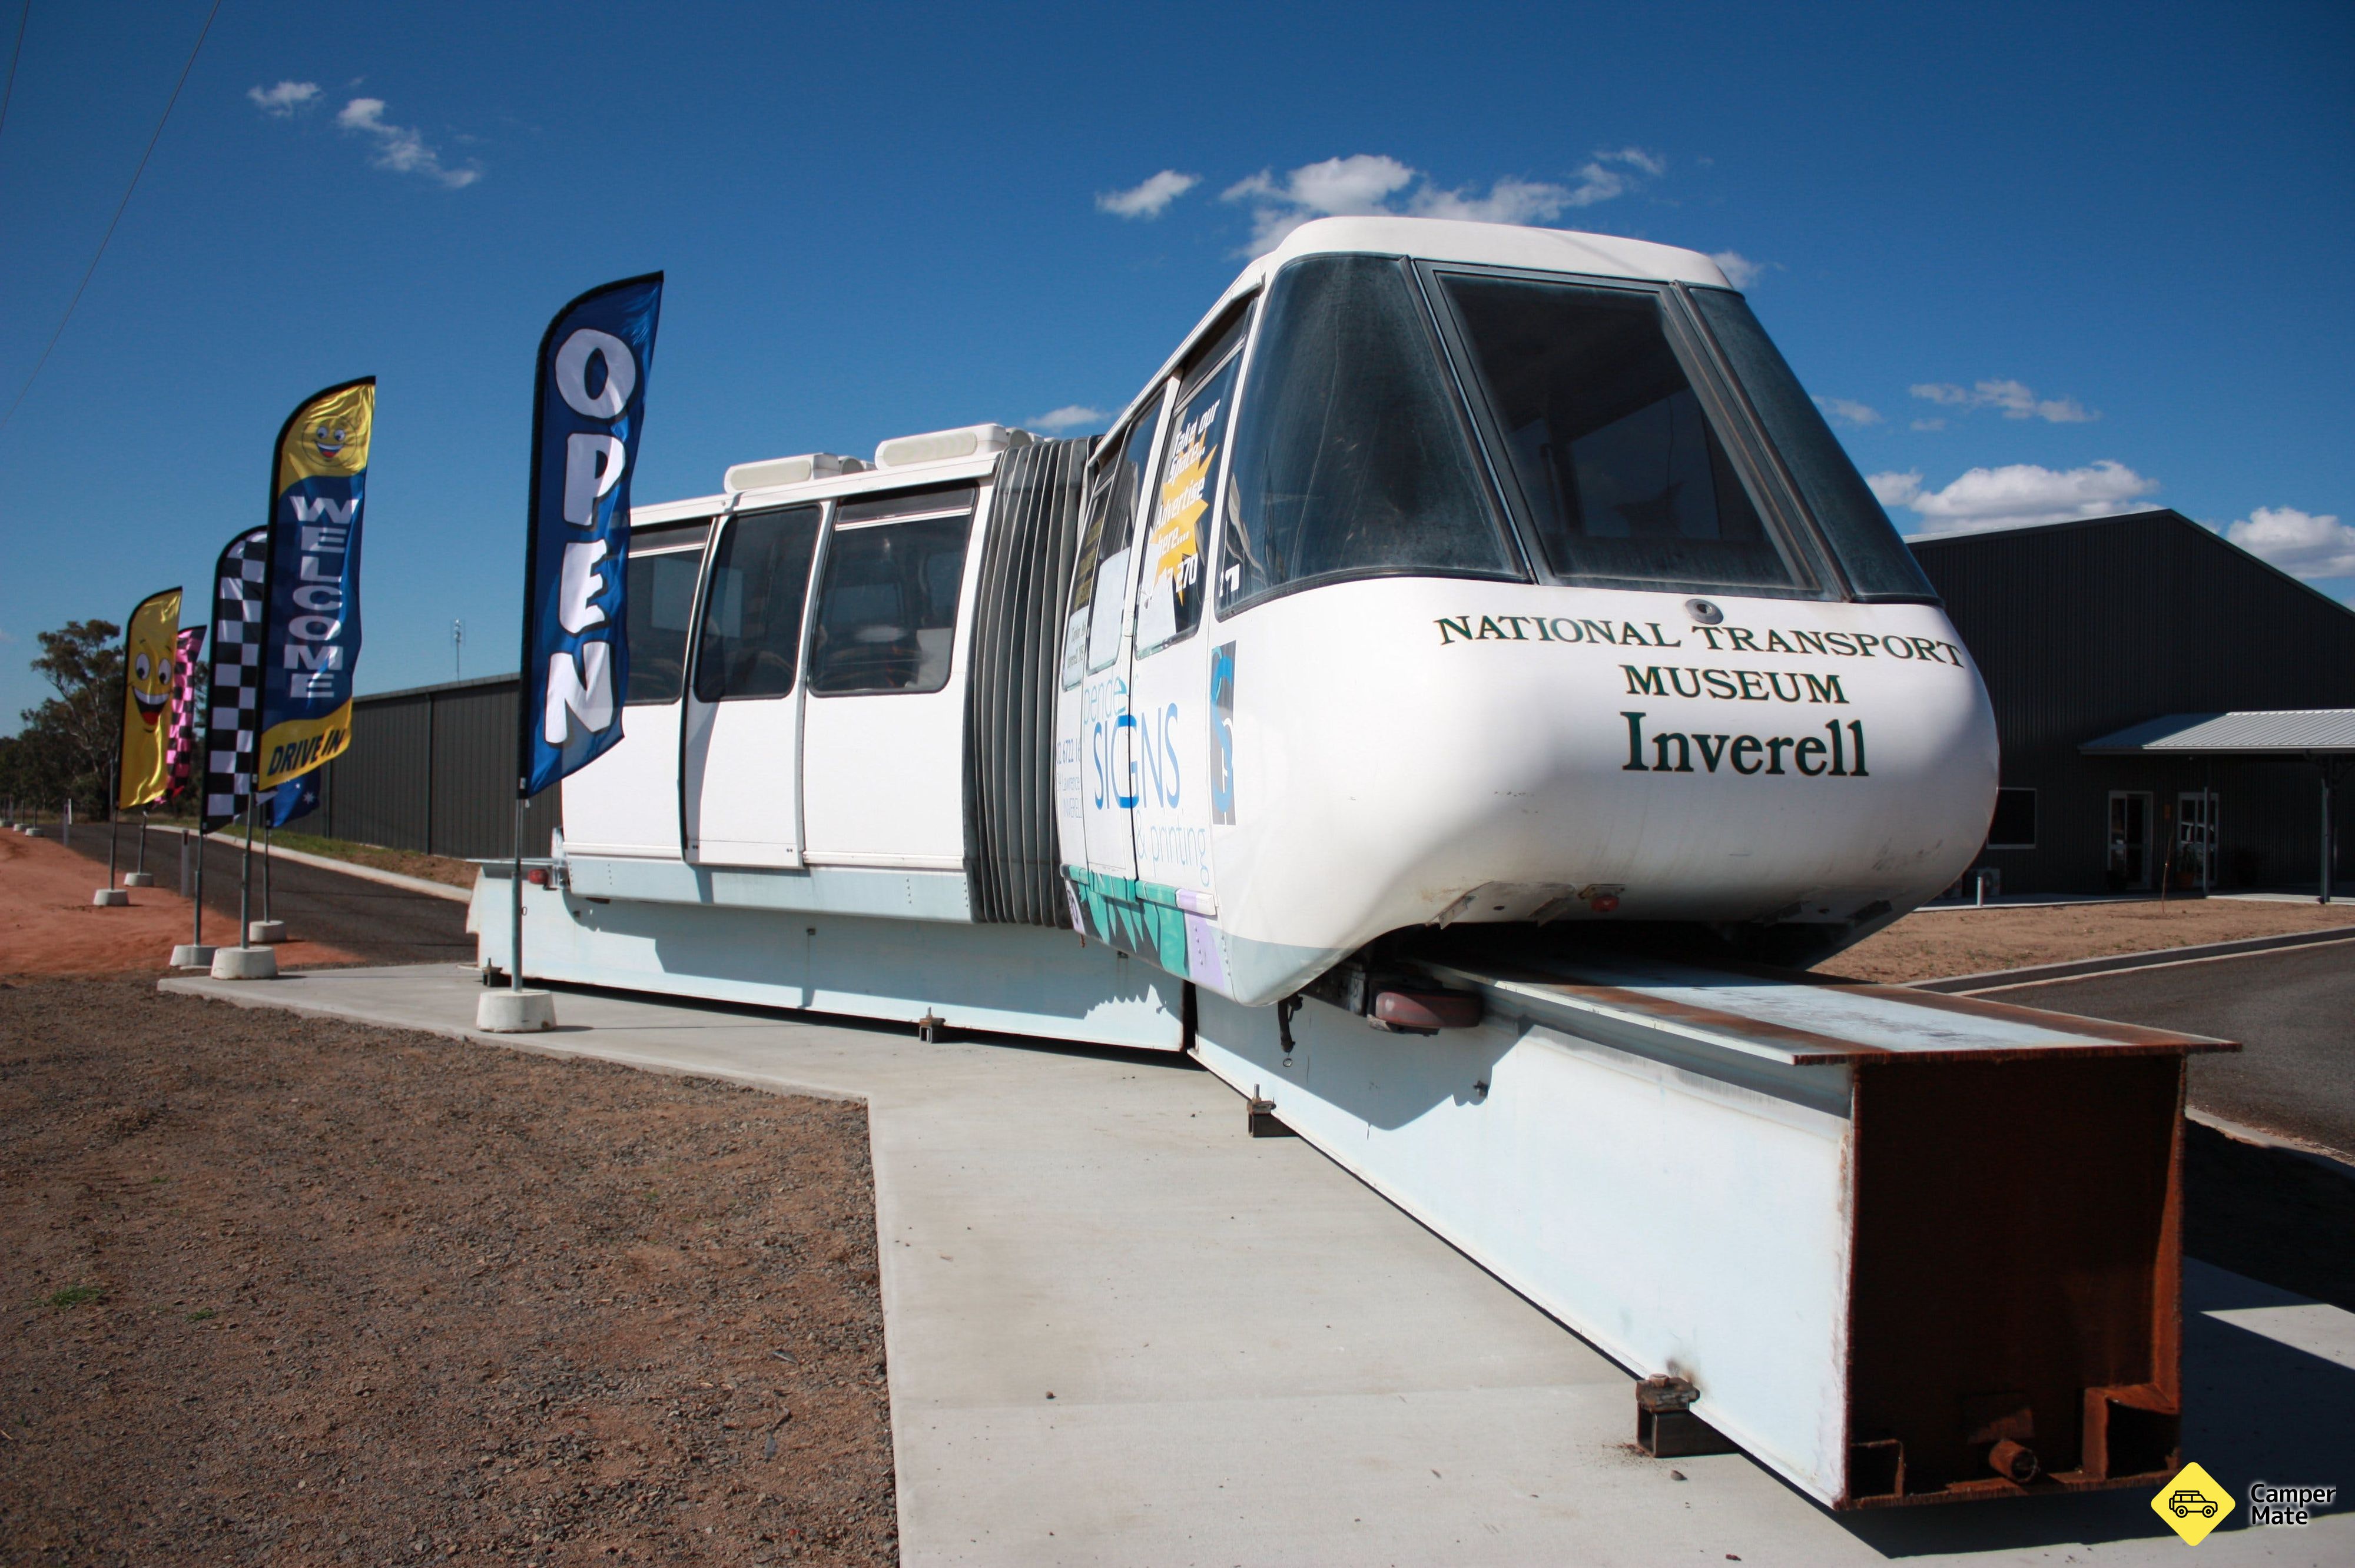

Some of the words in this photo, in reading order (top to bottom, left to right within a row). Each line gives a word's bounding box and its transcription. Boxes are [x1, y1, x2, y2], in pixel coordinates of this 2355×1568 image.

[1172, 421, 1198, 459] Take
[1198, 398, 1220, 435] our
[544, 327, 637, 745] OPEN
[1155, 477, 1205, 533] Advertise
[283, 496, 359, 699] WELCOME
[1432, 614, 1681, 648] NATIONAL
[1691, 626, 1965, 669] TRANSPORT
[1618, 663, 1850, 705] MUSEUM
[267, 733, 325, 777] DRIVE
[321, 728, 346, 756] IN
[1093, 703, 1180, 810] SIGNS
[1620, 711, 1870, 777] Inverell
[1150, 823, 1210, 887] printing
